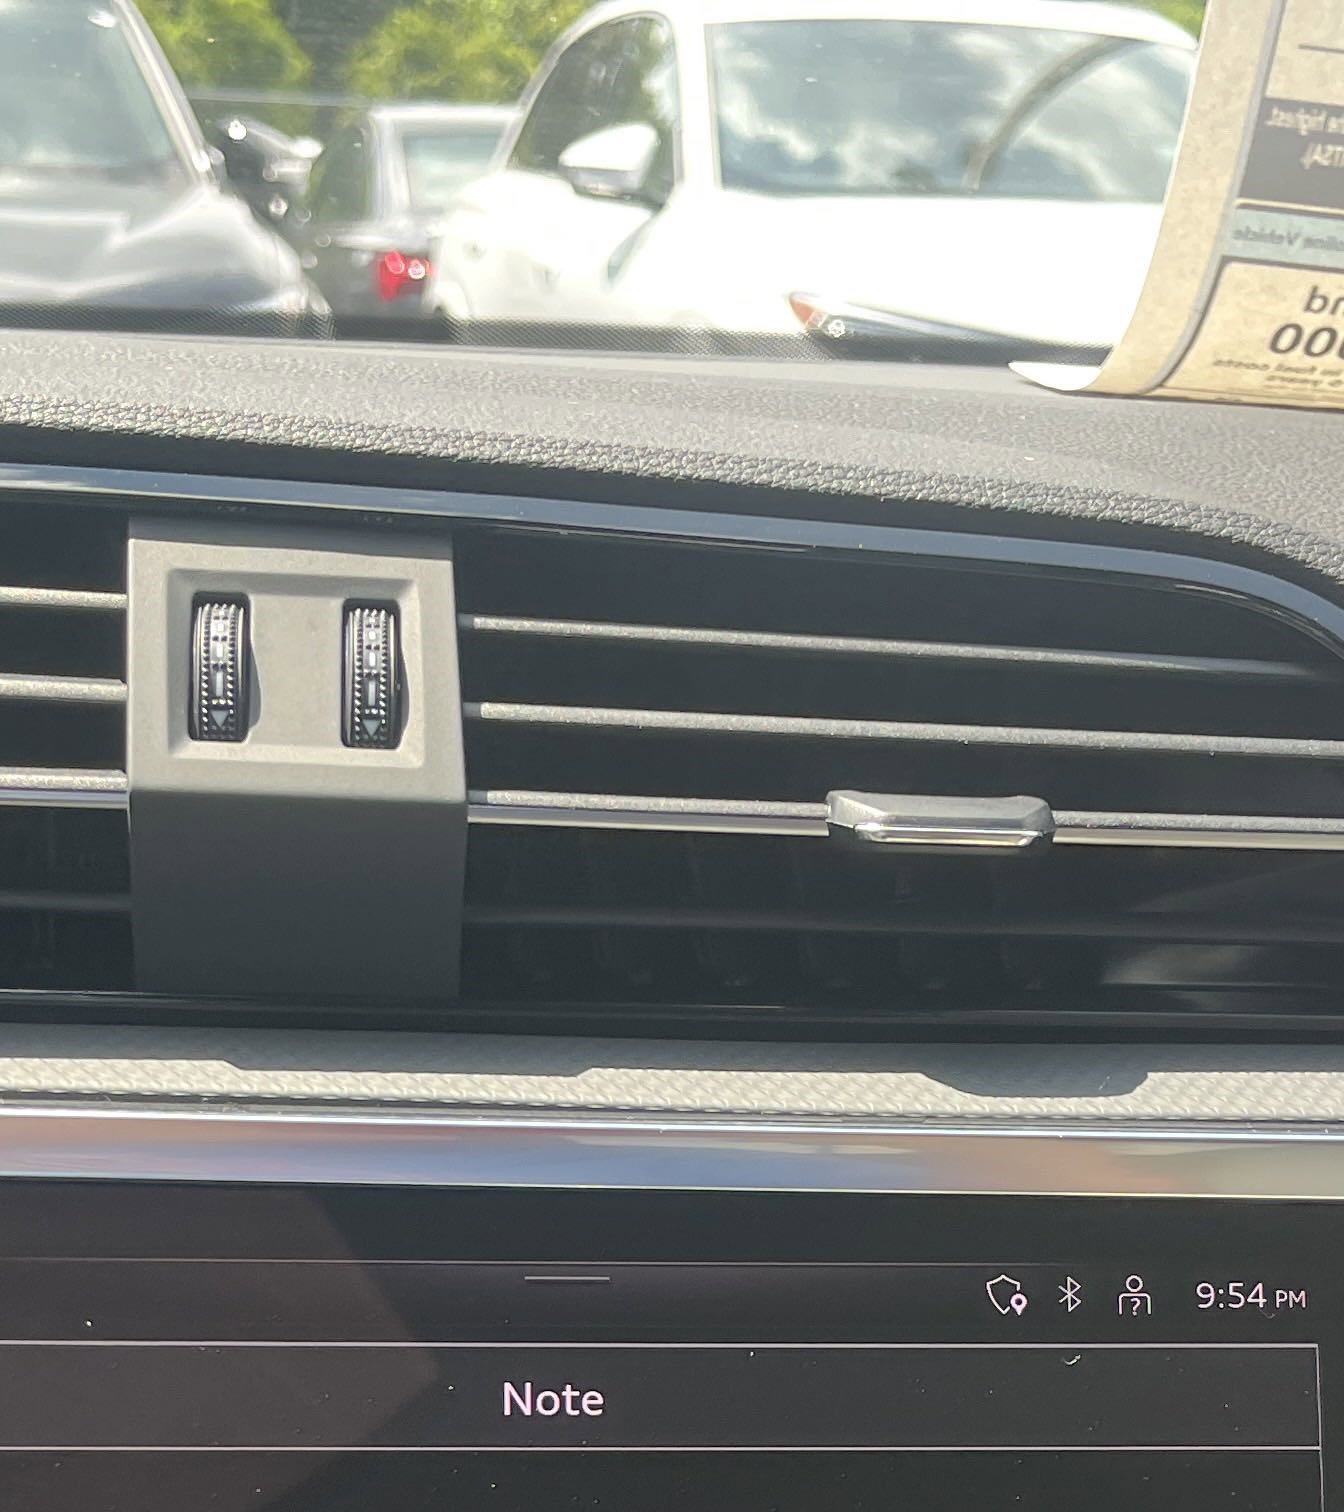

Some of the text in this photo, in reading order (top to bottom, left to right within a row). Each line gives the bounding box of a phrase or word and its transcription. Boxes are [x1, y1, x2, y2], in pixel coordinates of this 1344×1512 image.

[1196, 1281, 1307, 1309] 9:54 PM
[502, 1381, 605, 1417] Note
